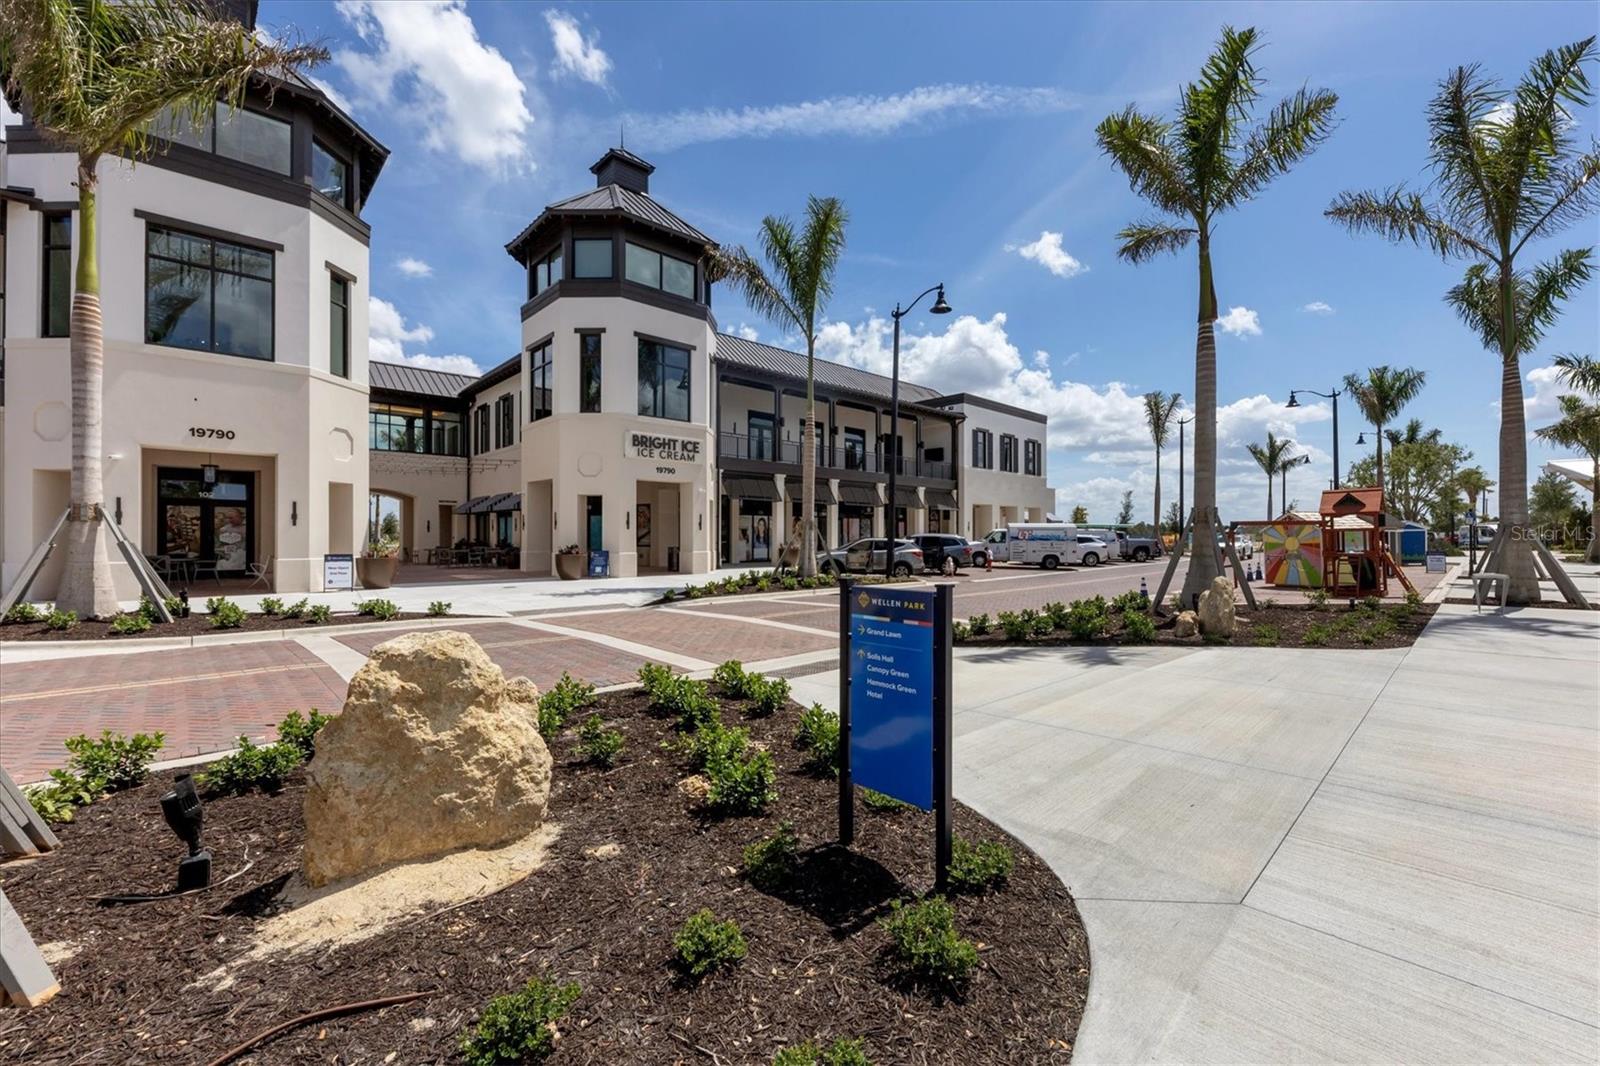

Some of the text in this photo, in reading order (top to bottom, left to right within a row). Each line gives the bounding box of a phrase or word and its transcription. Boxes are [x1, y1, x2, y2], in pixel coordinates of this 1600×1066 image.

[188, 427, 236, 440] 19790
[632, 434, 700, 453] BRIGHT ICE
[637, 448, 695, 462] ICE CREAM
[871, 598, 925, 610] WELLEN PARK
[866, 627, 902, 639] Grand Lawn
[866, 664, 910, 679] Canopy Green
[866, 678, 917, 695] Hammock Green
[866, 690, 883, 699] Hotel
